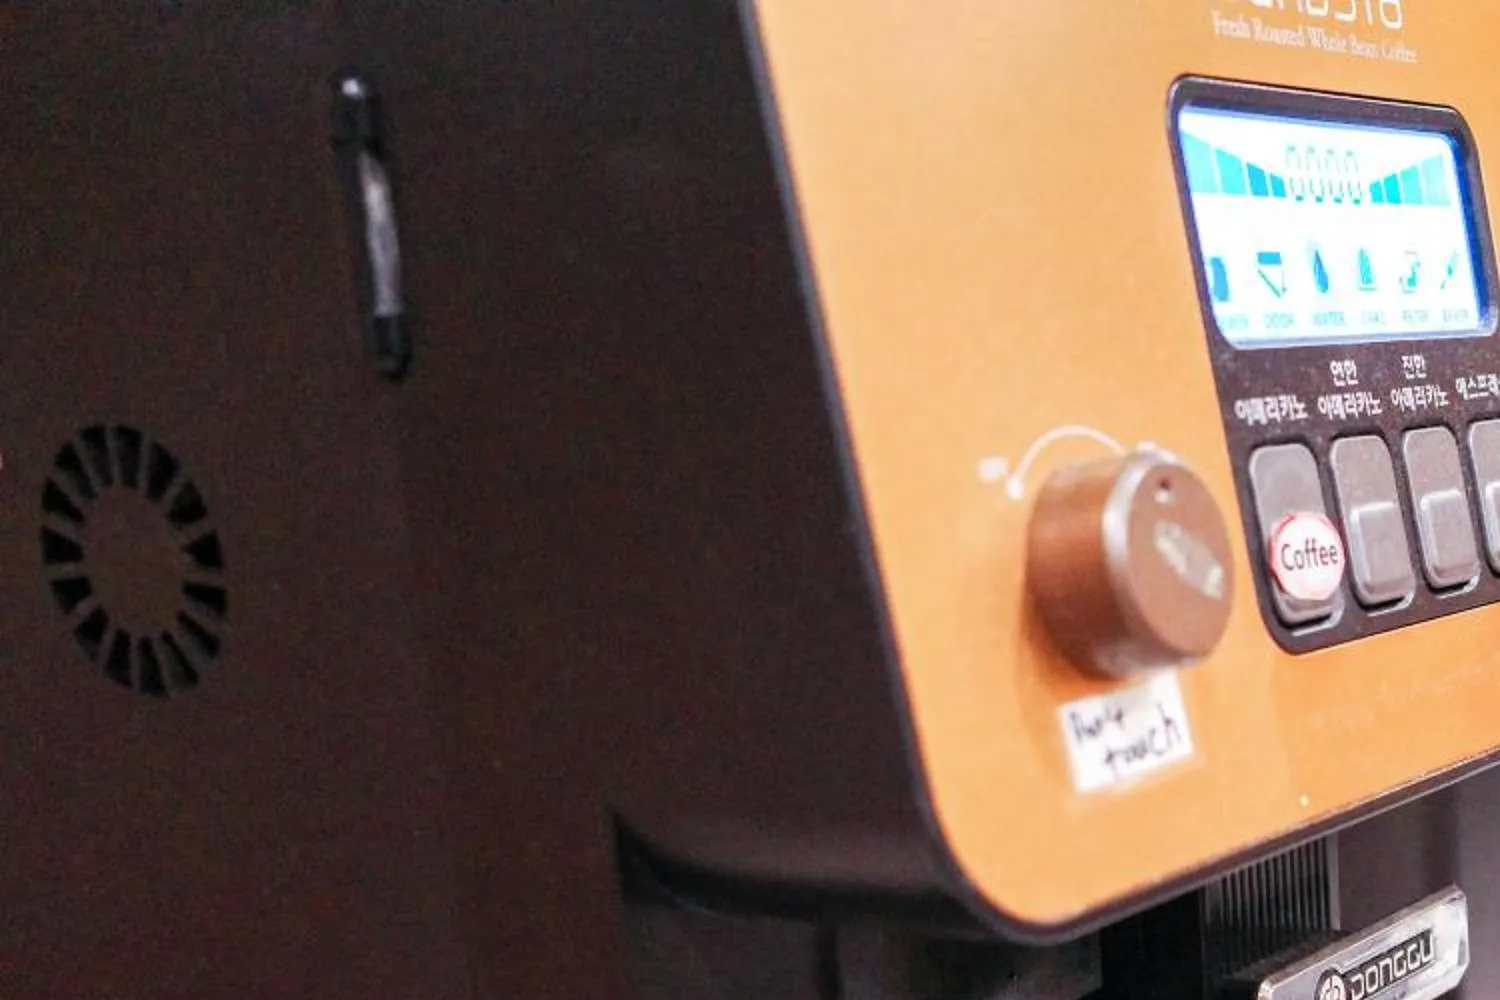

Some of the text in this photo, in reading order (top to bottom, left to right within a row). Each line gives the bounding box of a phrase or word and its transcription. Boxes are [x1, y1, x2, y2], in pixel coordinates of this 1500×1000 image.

[1329, 360, 1359, 387] 연한
[1317, 391, 1383, 420] 아메리카노
[1281, 539, 1339, 571] Coffee
